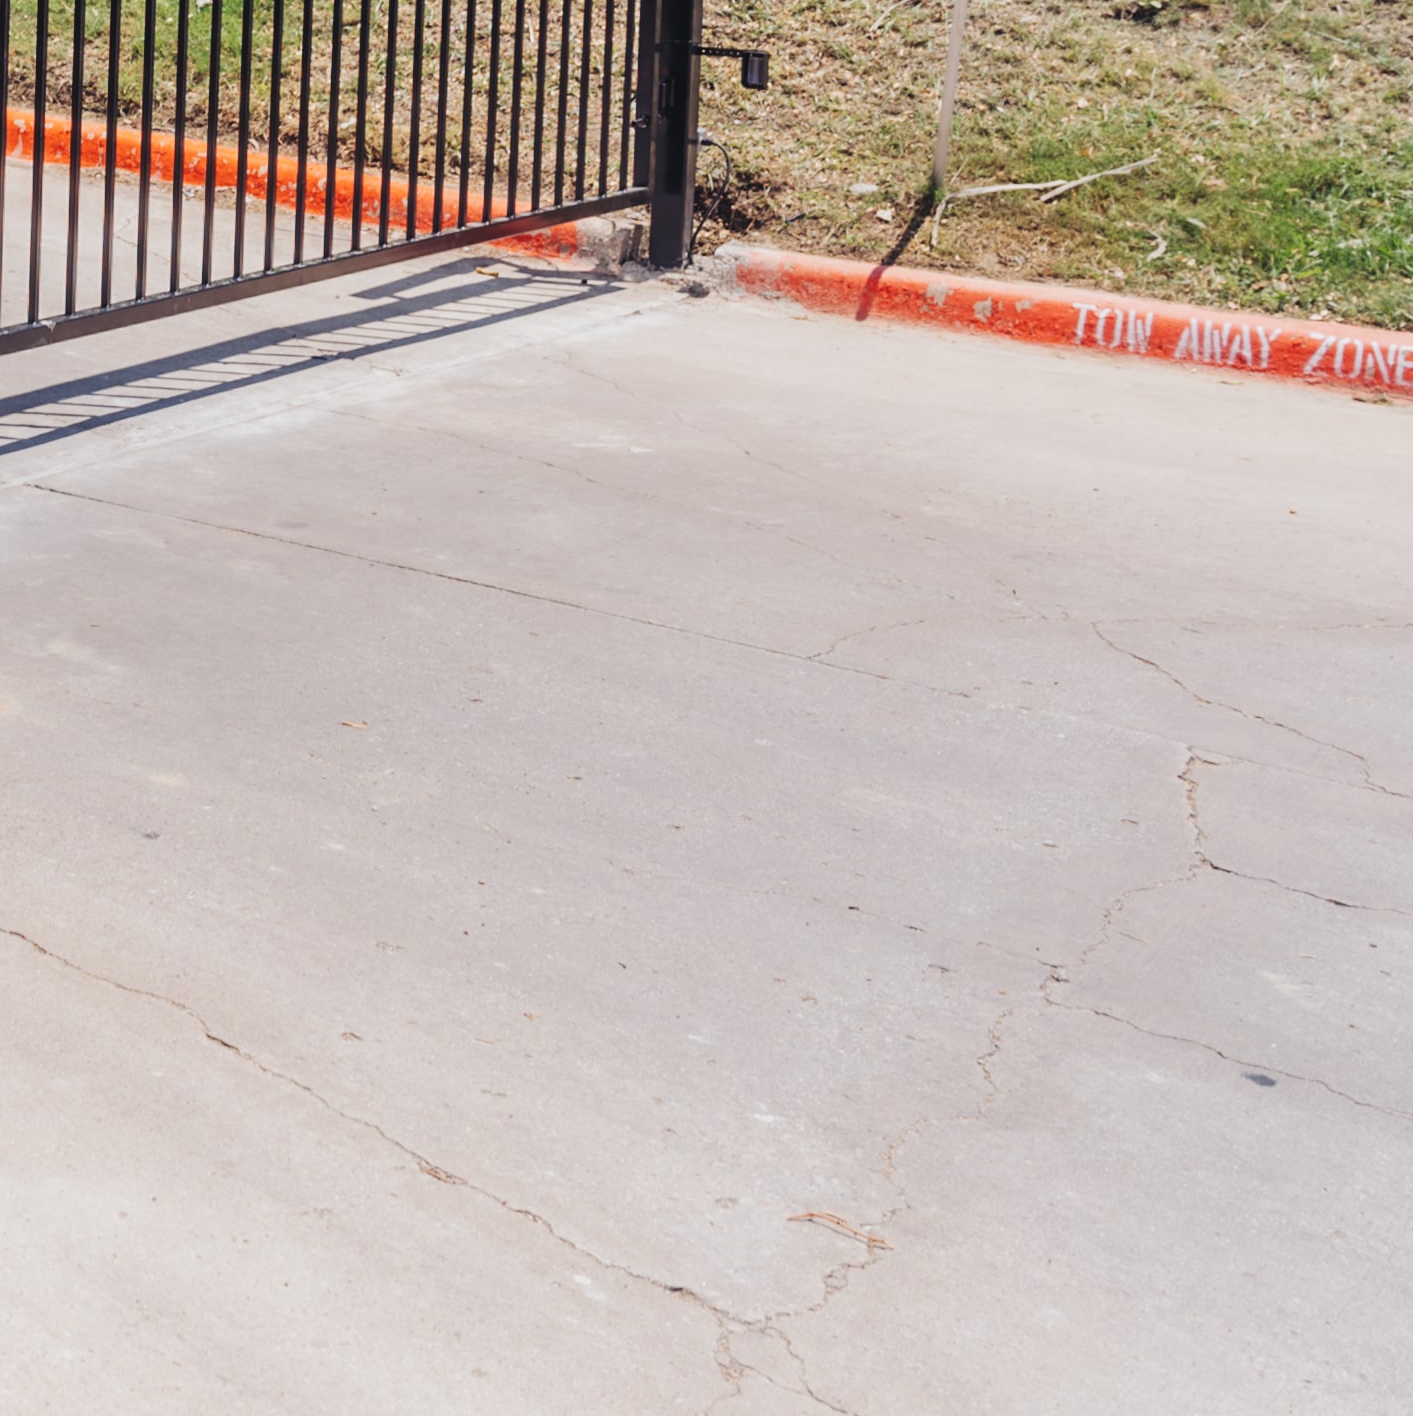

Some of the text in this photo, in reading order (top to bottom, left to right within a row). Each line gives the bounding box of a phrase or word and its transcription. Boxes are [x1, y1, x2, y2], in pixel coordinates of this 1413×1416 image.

[1074, 302, 1413, 386] TOW AWAY ZONE
